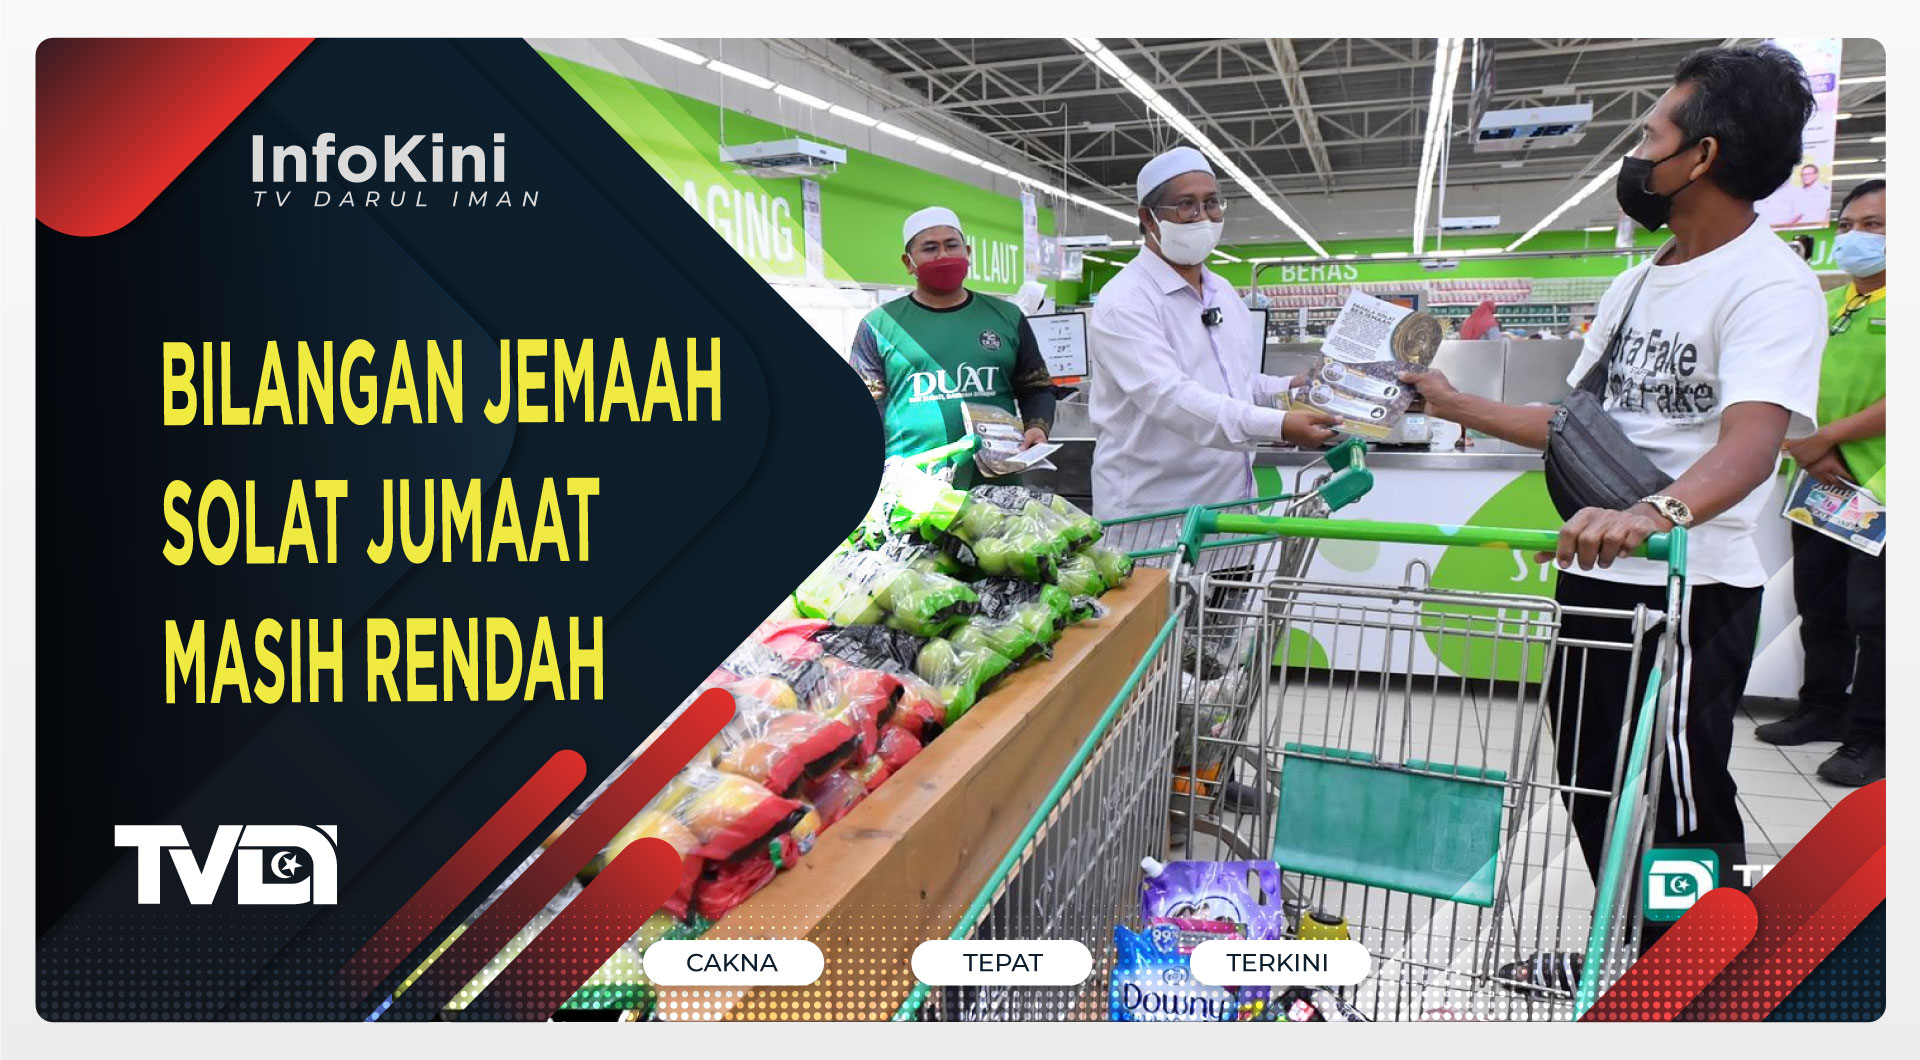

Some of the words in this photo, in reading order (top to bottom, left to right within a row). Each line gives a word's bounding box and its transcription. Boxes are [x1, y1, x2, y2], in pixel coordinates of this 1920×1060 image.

[982, 238, 1019, 286] LAUT
[1281, 263, 1359, 283] BERAS
[1641, 328, 1698, 378] Fake
[907, 361, 1000, 397] DUAT
[1123, 982, 1226, 1021] Downy
